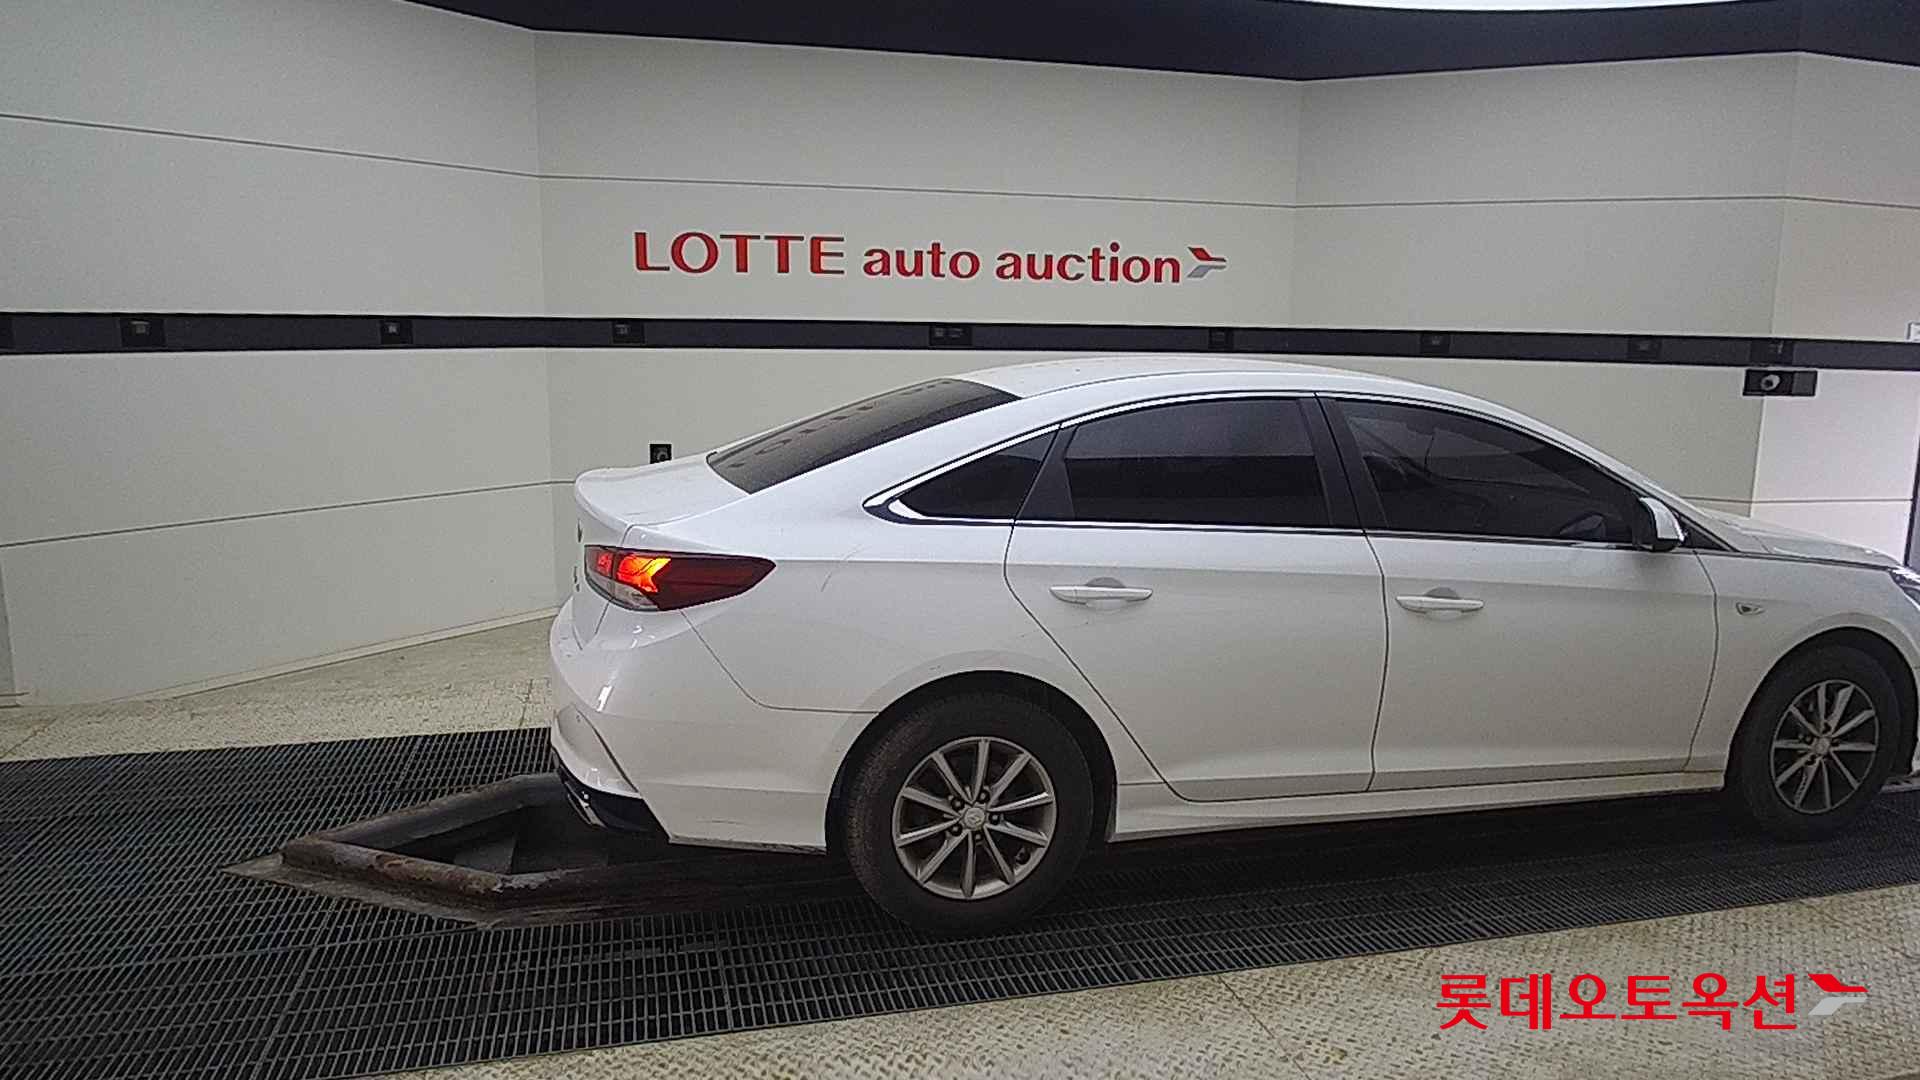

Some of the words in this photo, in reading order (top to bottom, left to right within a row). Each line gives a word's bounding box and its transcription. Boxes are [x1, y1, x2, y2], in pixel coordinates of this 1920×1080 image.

[634, 231, 845, 275] LOTTE
[863, 242, 981, 279] auto
[996, 242, 1181, 283] auction
